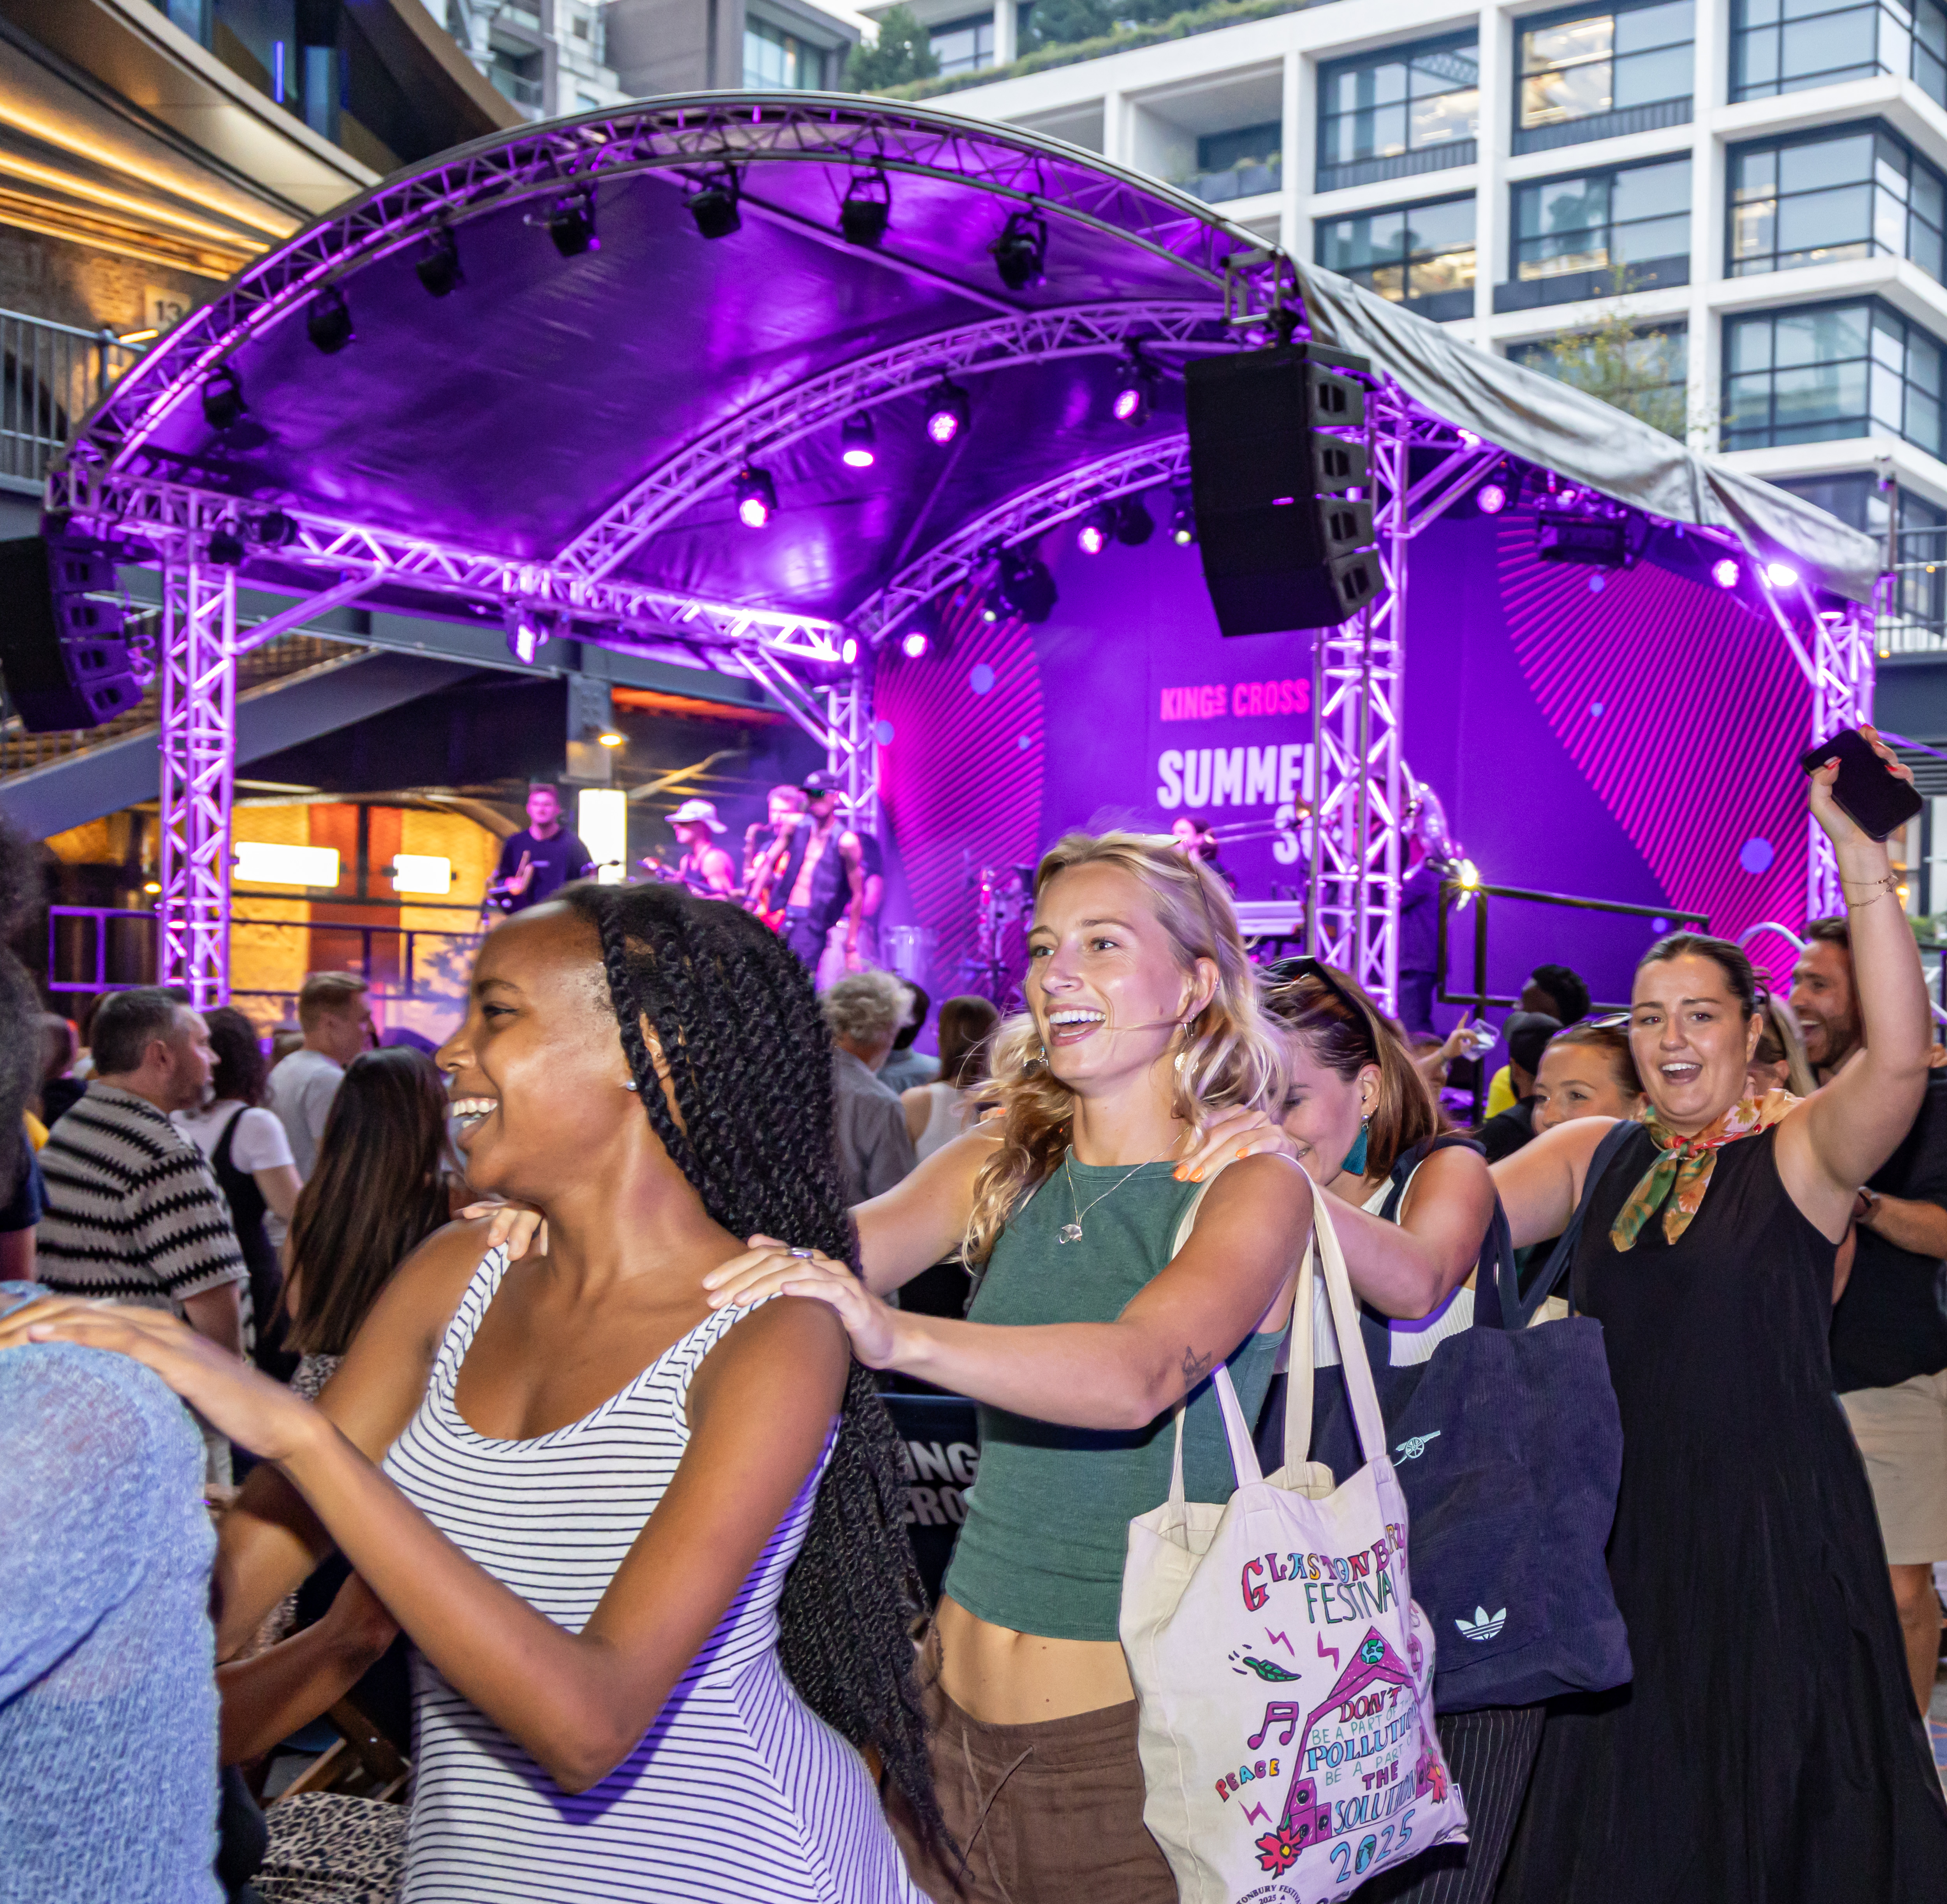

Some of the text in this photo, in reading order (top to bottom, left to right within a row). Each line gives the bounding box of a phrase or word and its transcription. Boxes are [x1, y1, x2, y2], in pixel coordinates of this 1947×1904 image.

[1232, 678, 1310, 717] CROSS
[1339, 1686, 1402, 1723] DON'T
[1312, 1729, 1331, 1745] BE
[1336, 1726, 1344, 1740] A
[1351, 1714, 1382, 1736] PART
[1386, 1706, 1396, 1721] OF
[1215, 1758, 1280, 1802] PEACE
[1326, 1768, 1341, 1786] BE
[1352, 1761, 1363, 1777] A
[1376, 1744, 1403, 1768] PART
[1362, 1760, 1399, 1791] THE
[1333, 1768, 1416, 1834] SOLUTION
[1330, 1809, 1415, 1883] 2025
